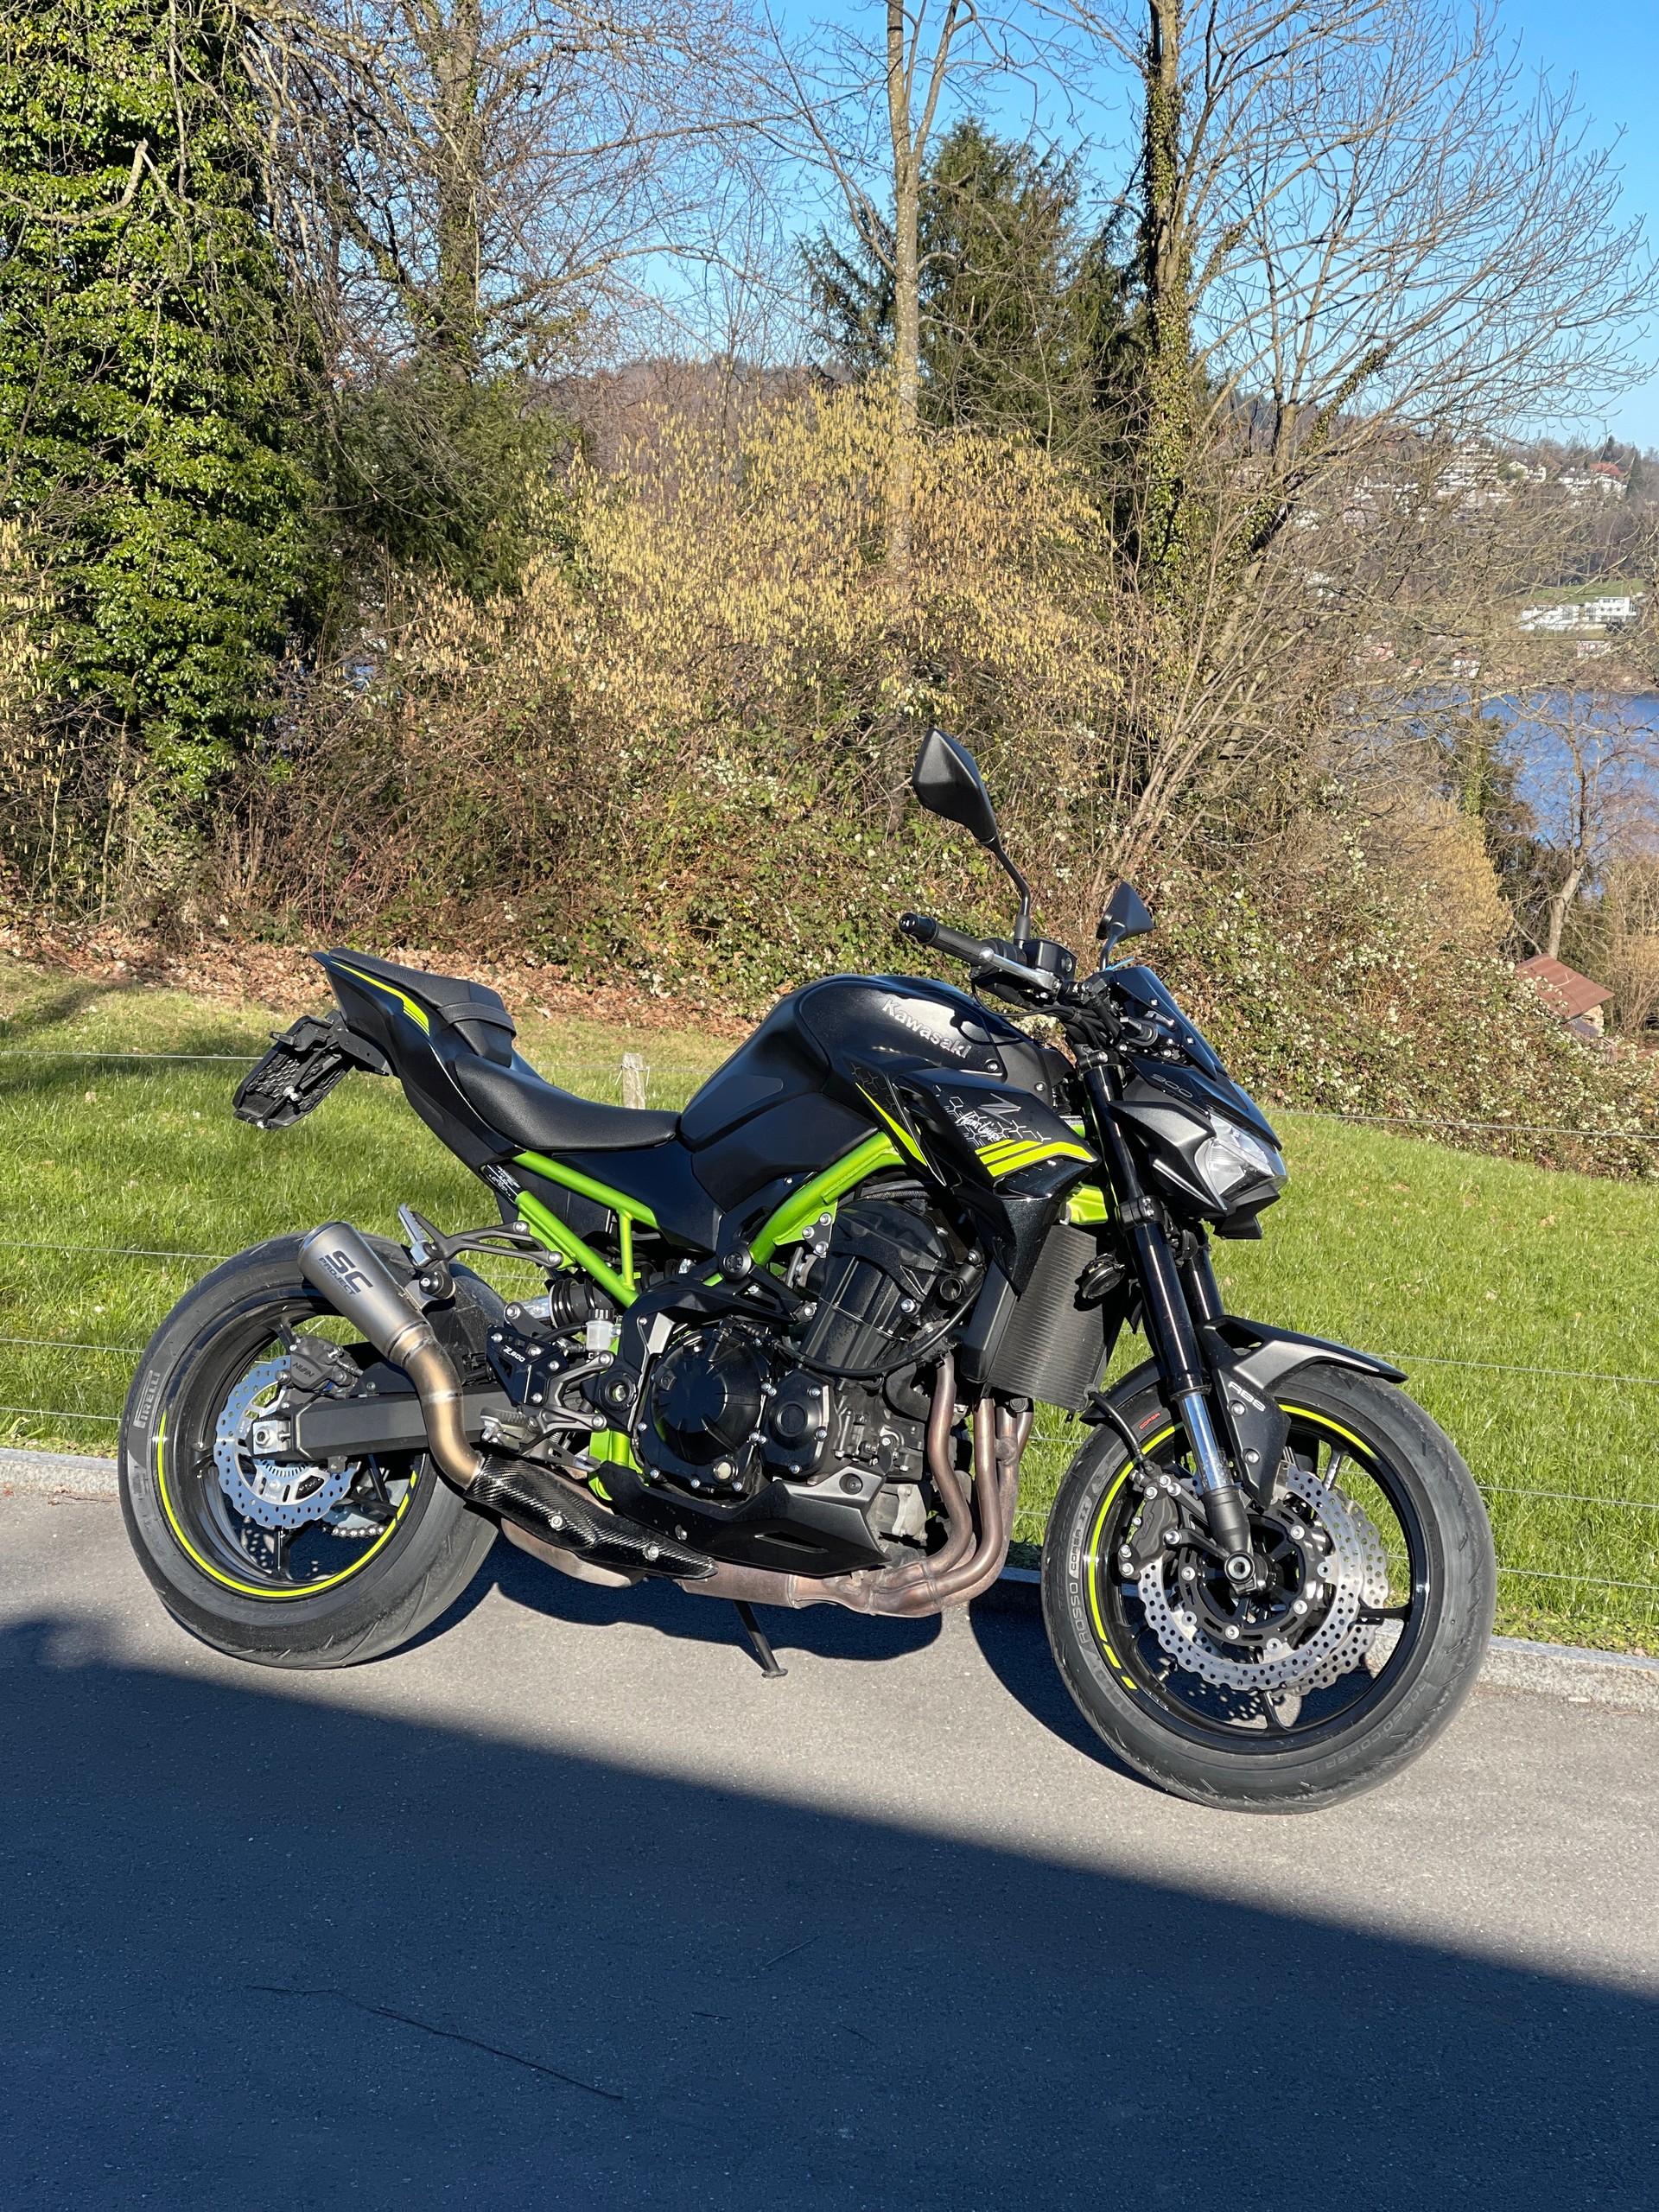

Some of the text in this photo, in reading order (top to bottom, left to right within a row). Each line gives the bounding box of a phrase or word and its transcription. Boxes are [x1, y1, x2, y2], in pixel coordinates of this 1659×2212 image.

[882, 999, 972, 1058] Kawasaki
[1151, 1074, 1192, 1097] 900
[319, 1257, 356, 1295] PROJECT
[325, 1250, 373, 1293] SC
[133, 1370, 161, 1428] PIRELLI
[1228, 1381, 1266, 1412] ABS
[1139, 1412, 1160, 1430] CORSA
[1071, 1529, 1082, 1572] CORSA
[1069, 1582, 1090, 1643] ROSSO
[1383, 1681, 1427, 1732] ROSSO
[1325, 1732, 1382, 1770] CORSA
